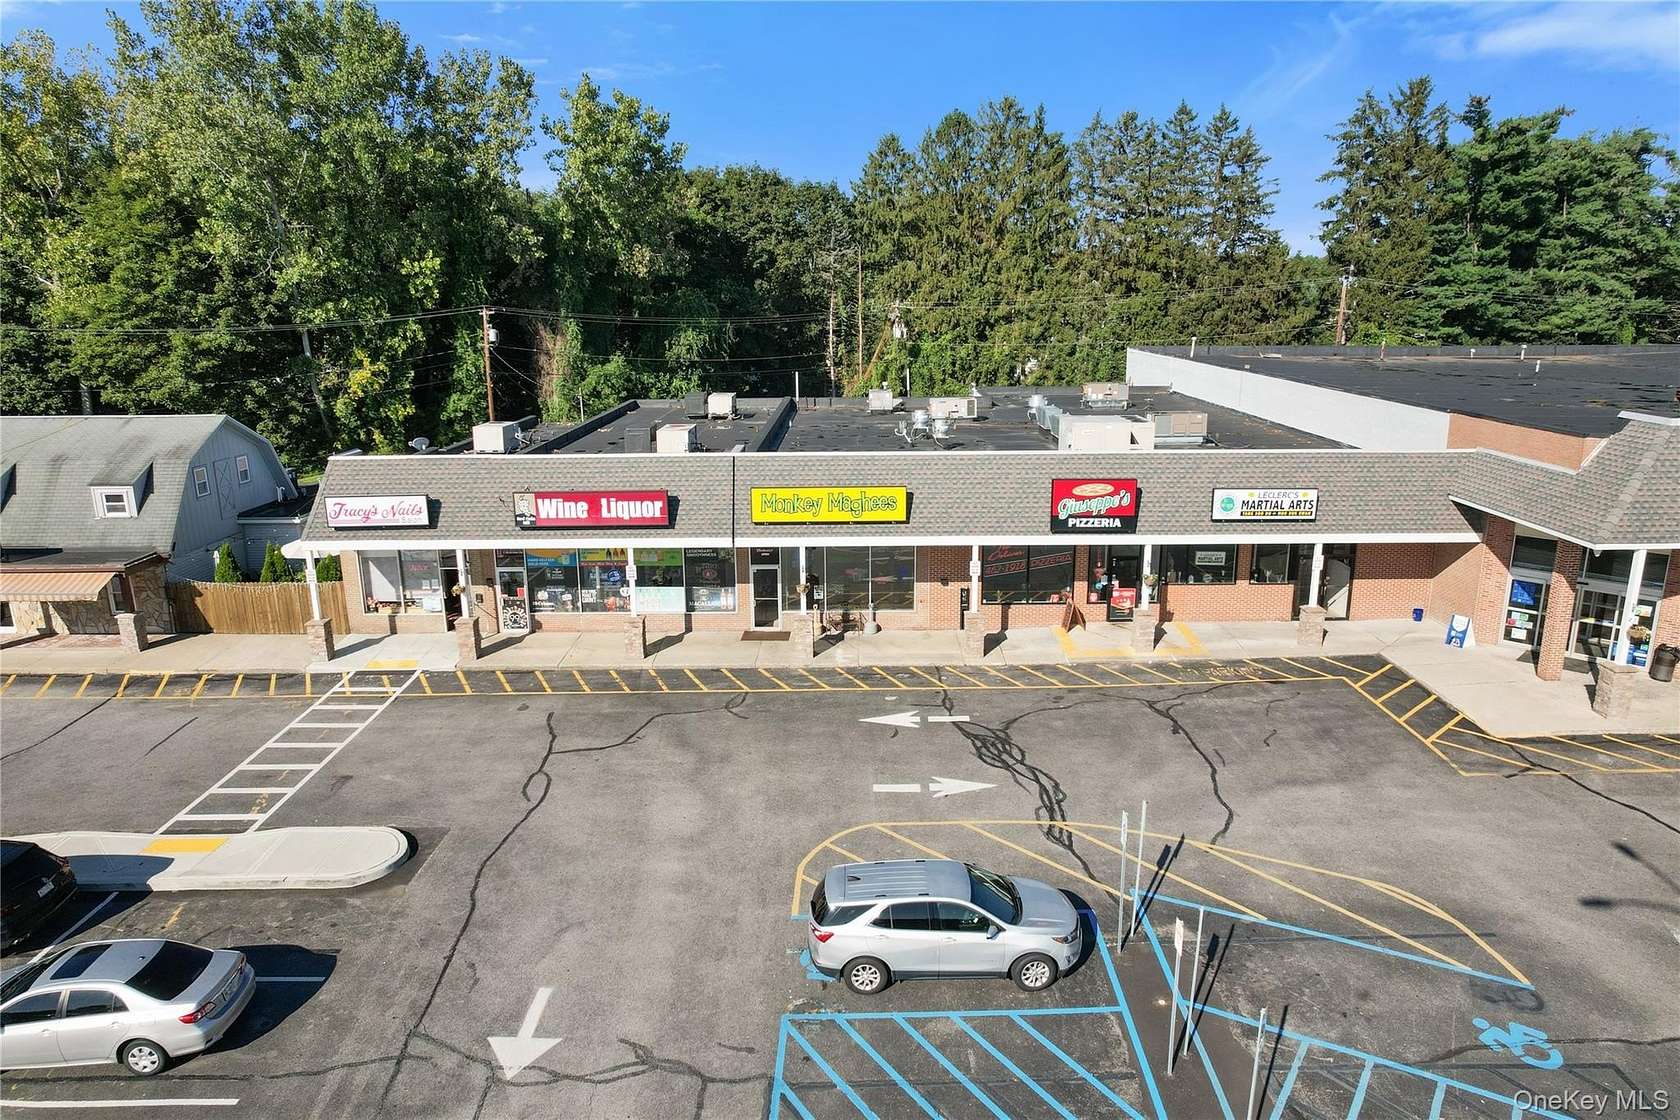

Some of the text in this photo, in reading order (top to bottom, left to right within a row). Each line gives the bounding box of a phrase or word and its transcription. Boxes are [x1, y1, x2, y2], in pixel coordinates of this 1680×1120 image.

[760, 491, 897, 518] Monkey Maghees
[1057, 489, 1131, 520] Giuseppe's
[1241, 500, 1314, 510] MARTIAL ARTS
[1257, 491, 1300, 499] LECLERC'S
[329, 501, 422, 523] Tracy's Nails
[536, 497, 663, 520] Wine Liquor
[1068, 518, 1122, 528] PIZZERIA
